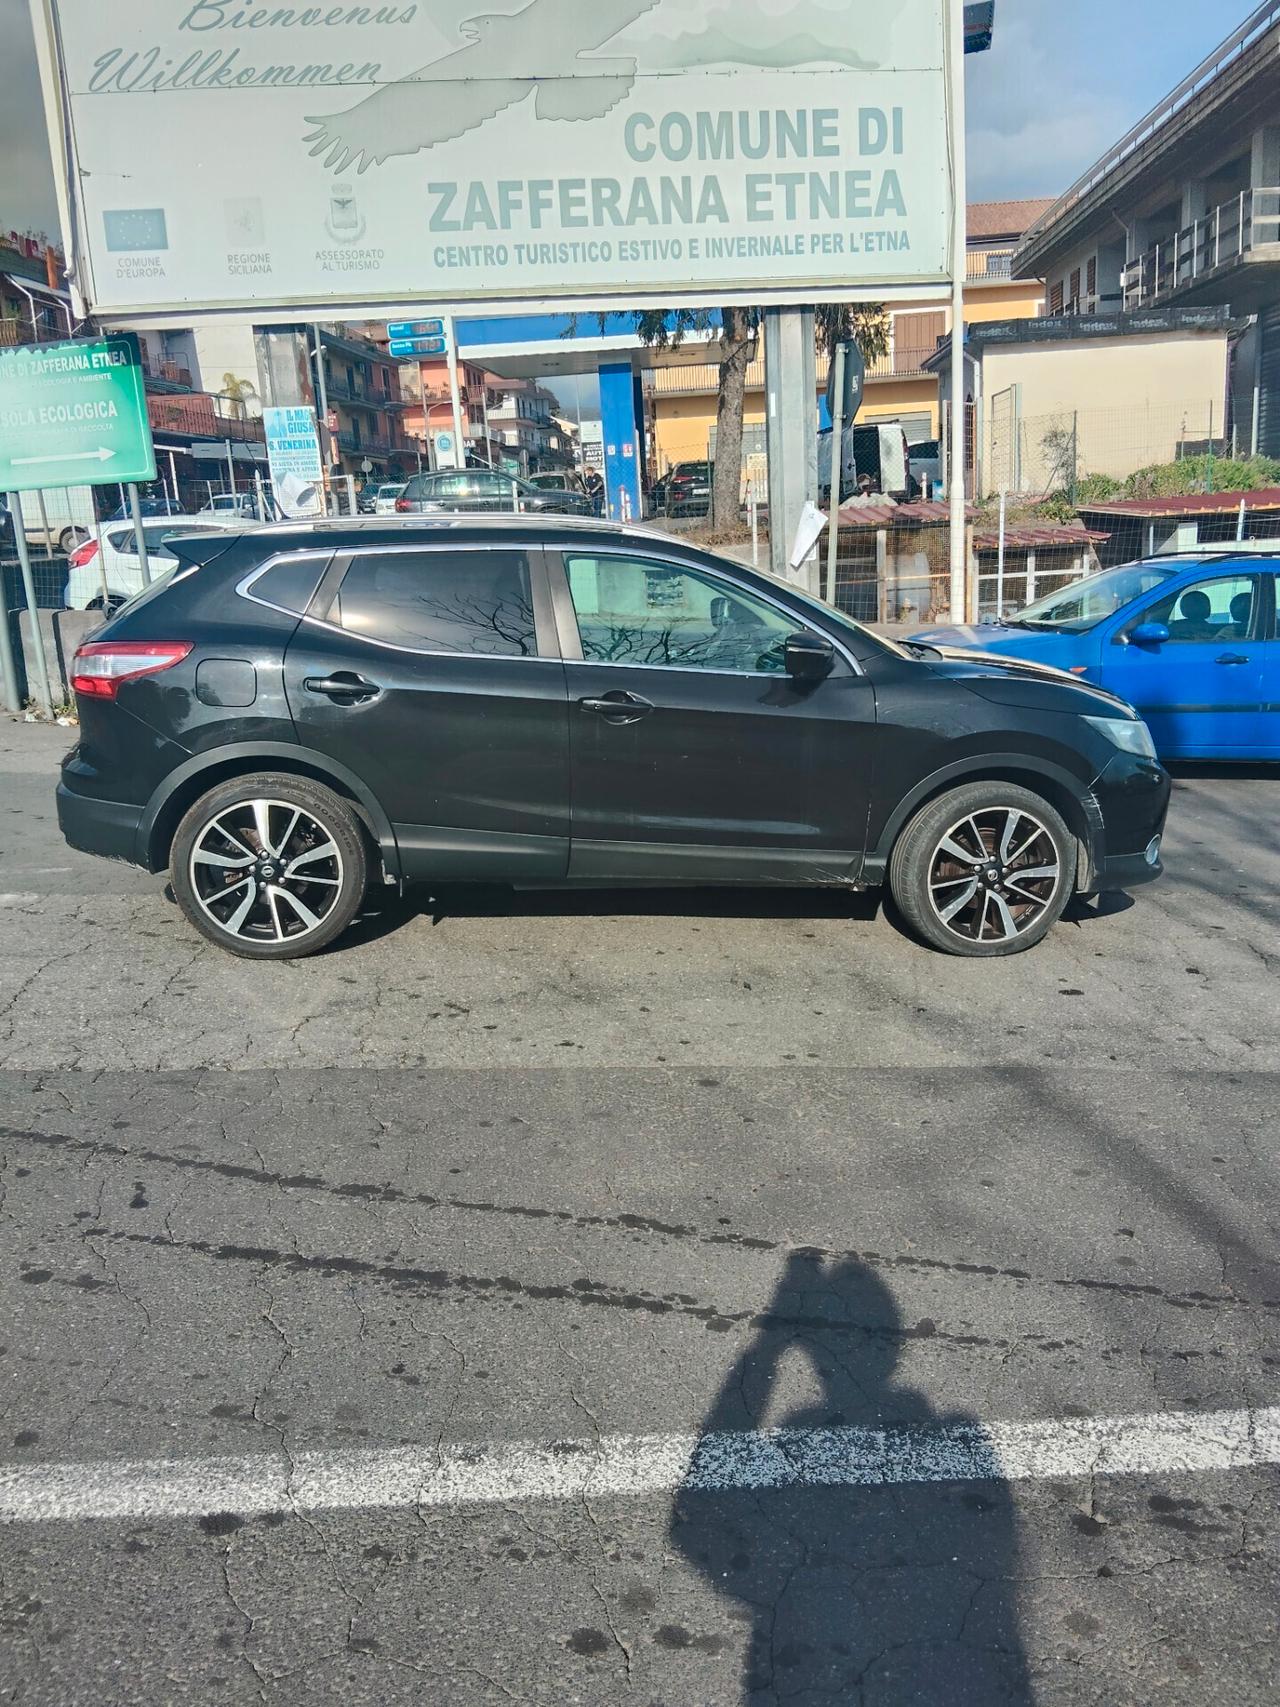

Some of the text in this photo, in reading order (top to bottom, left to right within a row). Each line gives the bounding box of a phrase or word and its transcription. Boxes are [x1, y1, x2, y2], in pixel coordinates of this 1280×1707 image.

[178, 0, 418, 31] Bienvenus
[88, 46, 385, 92] Willkommen
[624, 106, 904, 163] COMUNE DI
[427, 169, 908, 232] ZAFFERANA ETNEA
[433, 230, 911, 268] CENTRO TURISTICO ESTIVO E INVERNALE PER L'ETNA
[227, 254, 272, 265] REGIONE
[315, 249, 385, 263] ASSESSORATO
[117, 257, 161, 270] COMUNE
[228, 264, 273, 276] SICILIANA
[321, 260, 381, 272] AL TURISMO
[116, 267, 167, 279] D'EUROPA
[0, 351, 127, 379] NE DI ZAFFERANA ETNEA
[79, 373, 112, 384] AMBIENTE
[39, 401, 118, 424] ECOLOGICA
[286, 409, 294, 422] IL
[288, 422, 315, 433] GIUSA
[268, 439, 317, 451] S. VENERINA
